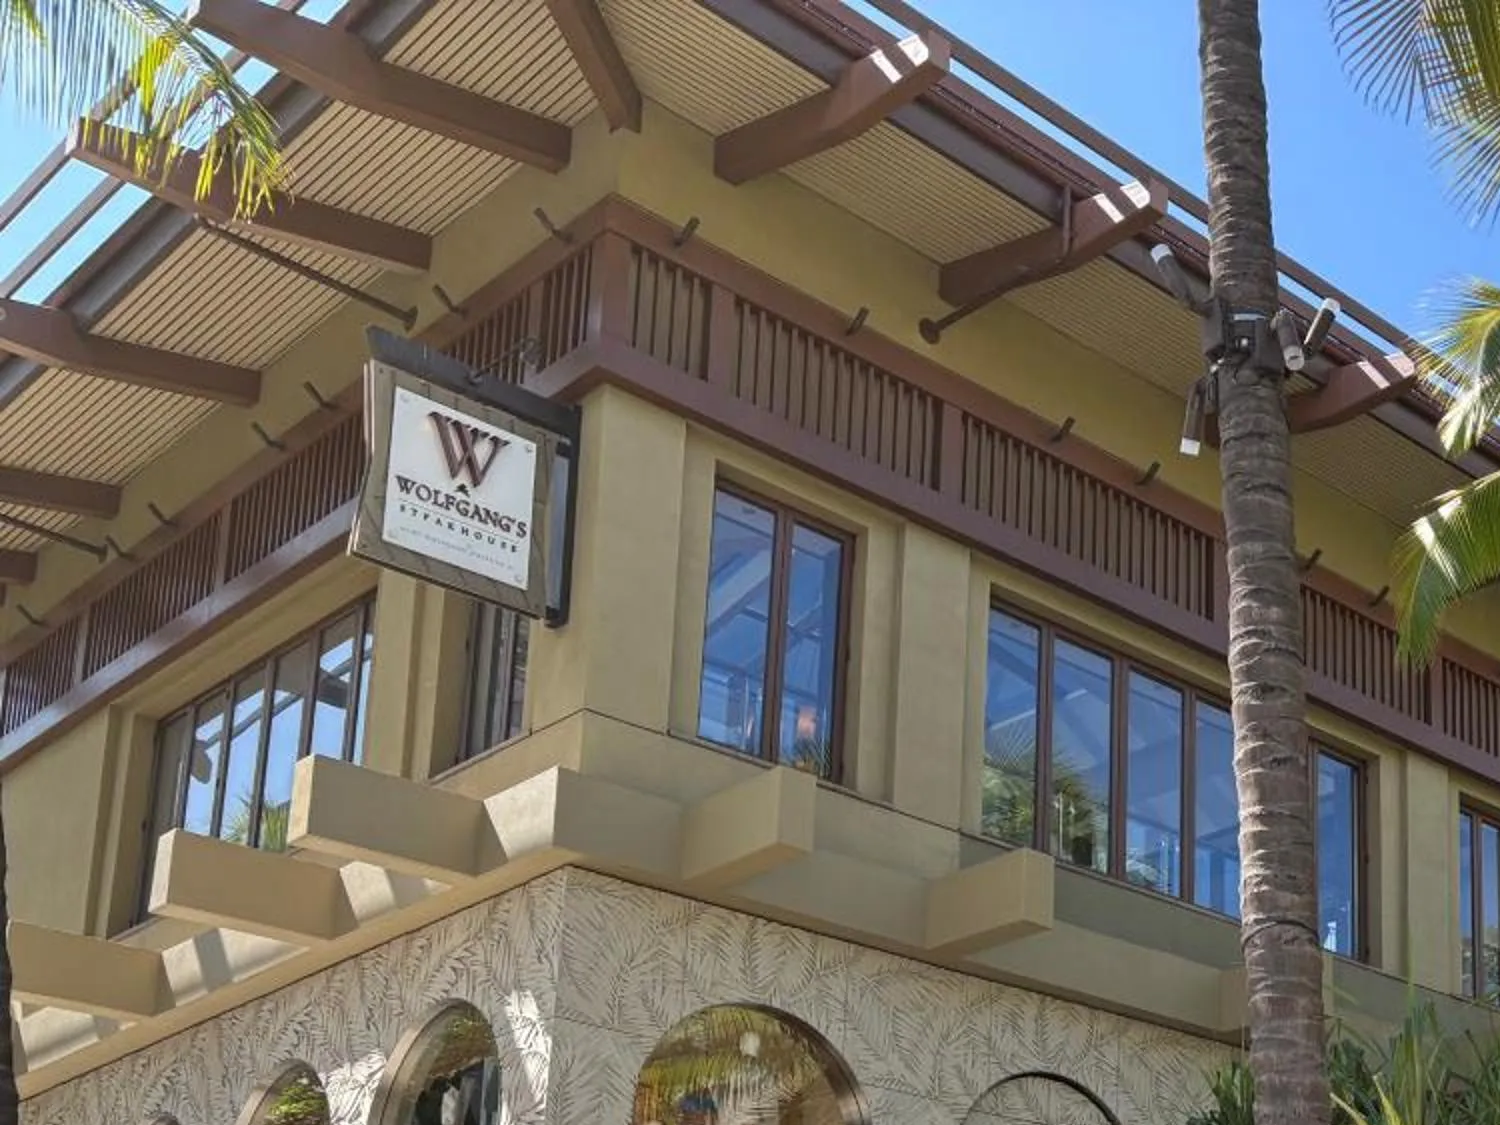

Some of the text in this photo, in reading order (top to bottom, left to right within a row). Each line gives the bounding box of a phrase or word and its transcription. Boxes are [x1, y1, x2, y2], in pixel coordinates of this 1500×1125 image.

[429, 411, 511, 488] W
[395, 475, 528, 538] WOLFGANG'S
[399, 504, 520, 553] STEAKHOUSE
